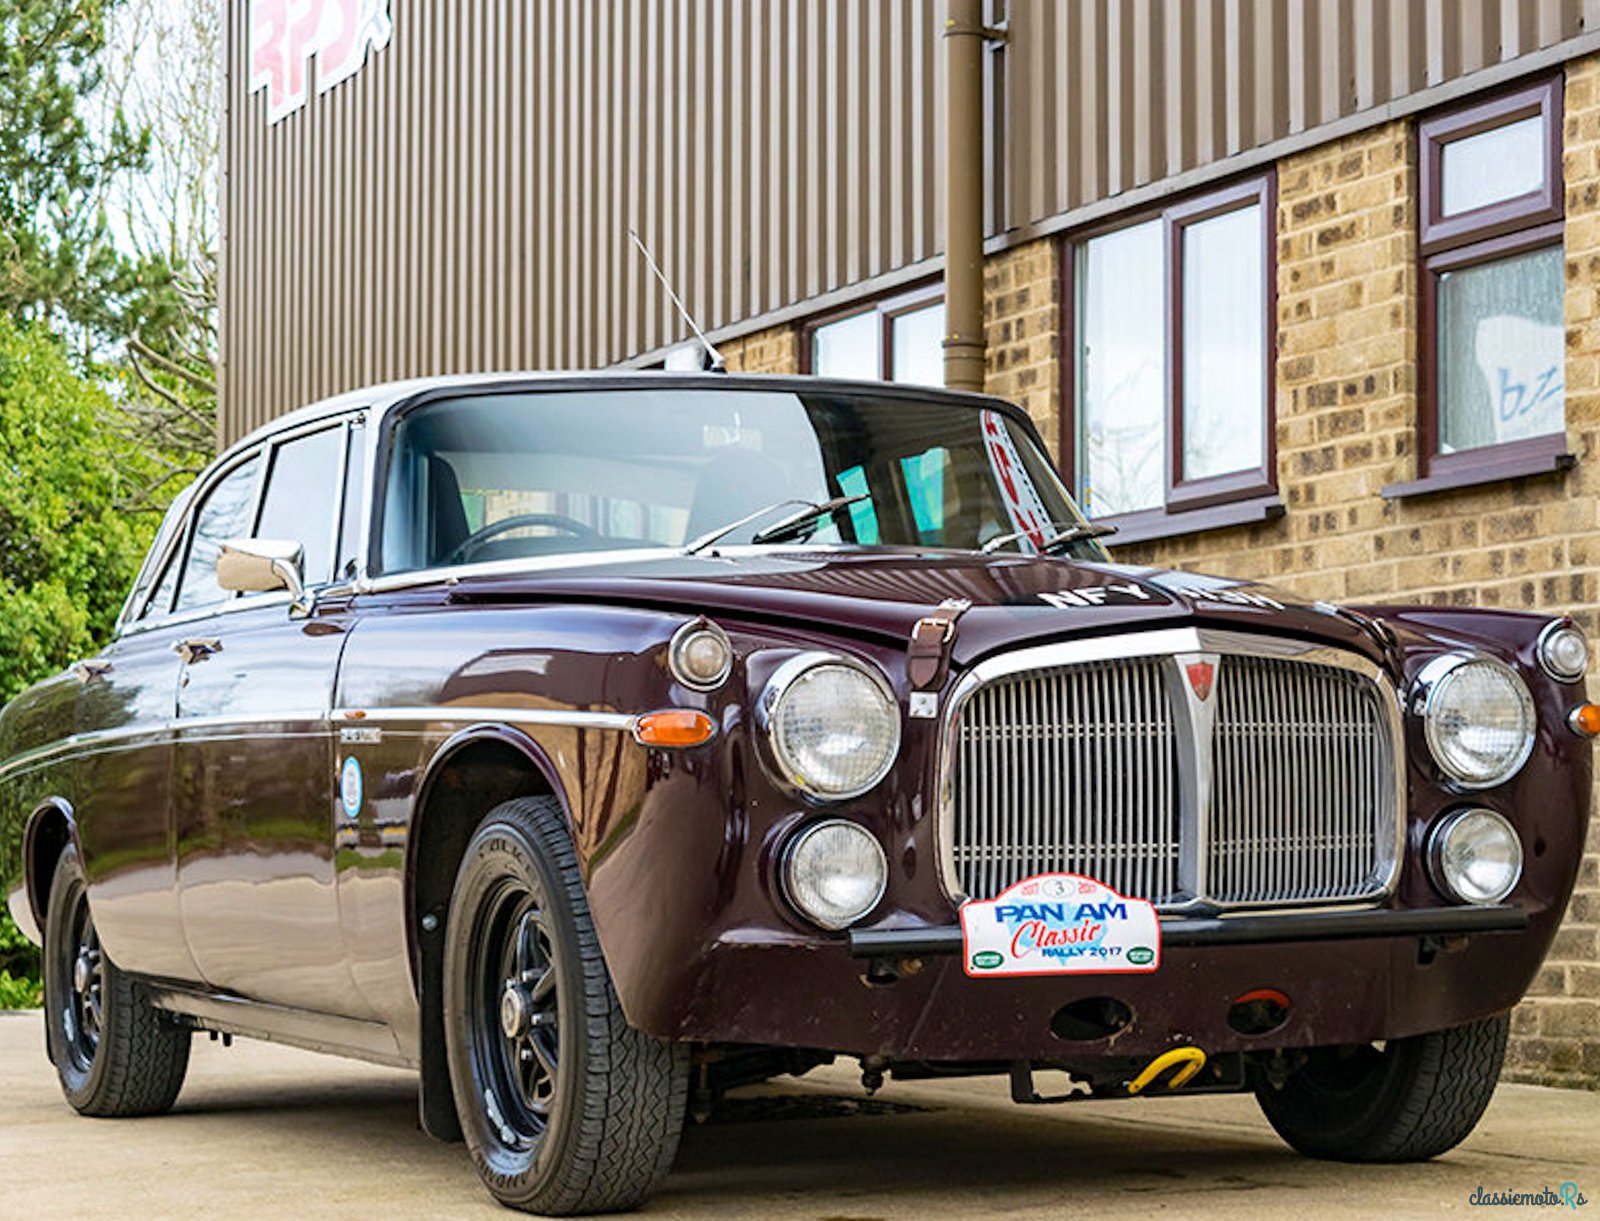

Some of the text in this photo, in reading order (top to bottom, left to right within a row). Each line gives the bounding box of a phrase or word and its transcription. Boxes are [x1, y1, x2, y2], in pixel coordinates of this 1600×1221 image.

[1037, 584, 1150, 610] NFY
[1054, 880, 1065, 896] 3
[994, 902, 1129, 922] PAN AM
[1010, 919, 1101, 959] Classic
[1041, 947, 1087, 958] RALLY
[1090, 946, 1123, 959] 2017
